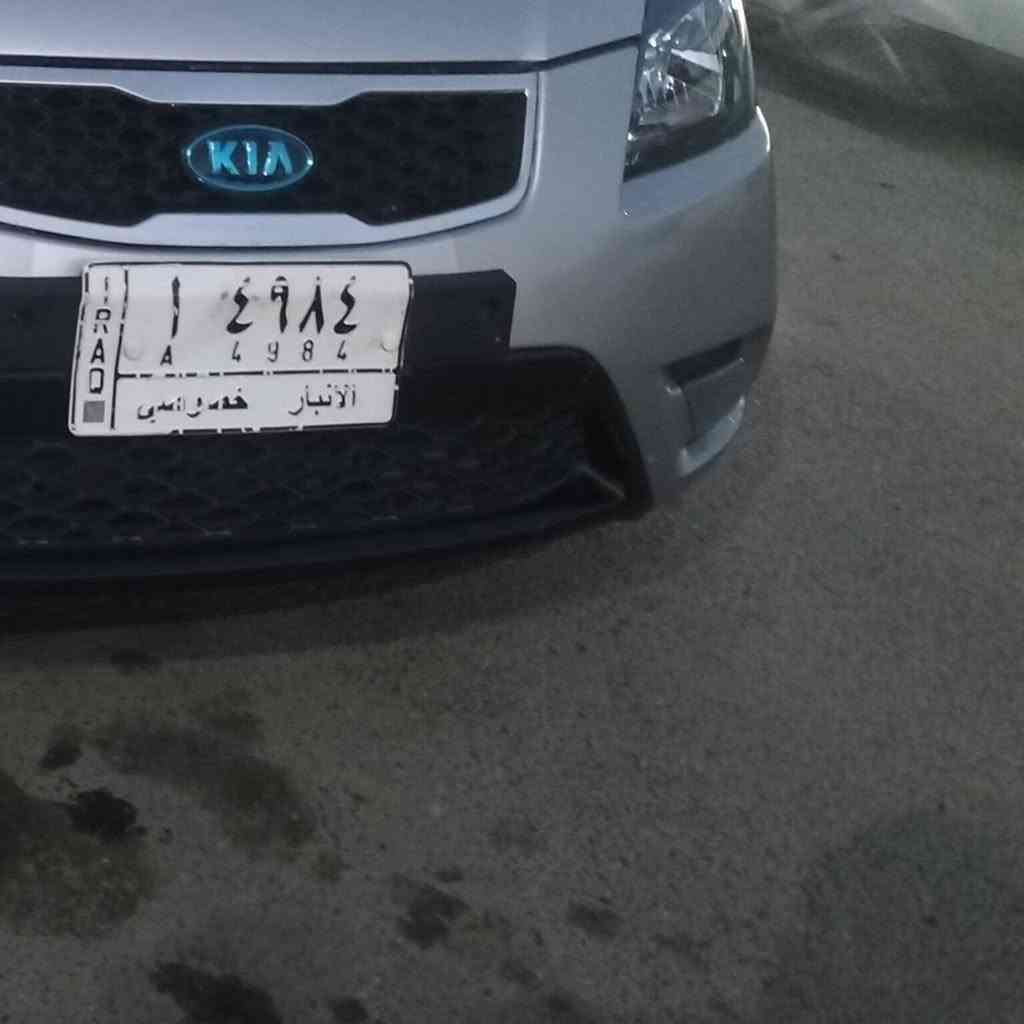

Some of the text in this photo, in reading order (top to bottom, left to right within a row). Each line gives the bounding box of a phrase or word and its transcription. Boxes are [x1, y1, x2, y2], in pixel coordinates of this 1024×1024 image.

[206, 139, 294, 177] KIA
[225, 275, 359, 335] ٤٩٨٤
[89, 275, 112, 395] IRAQ
[159, 339, 348, 367] A 4984
